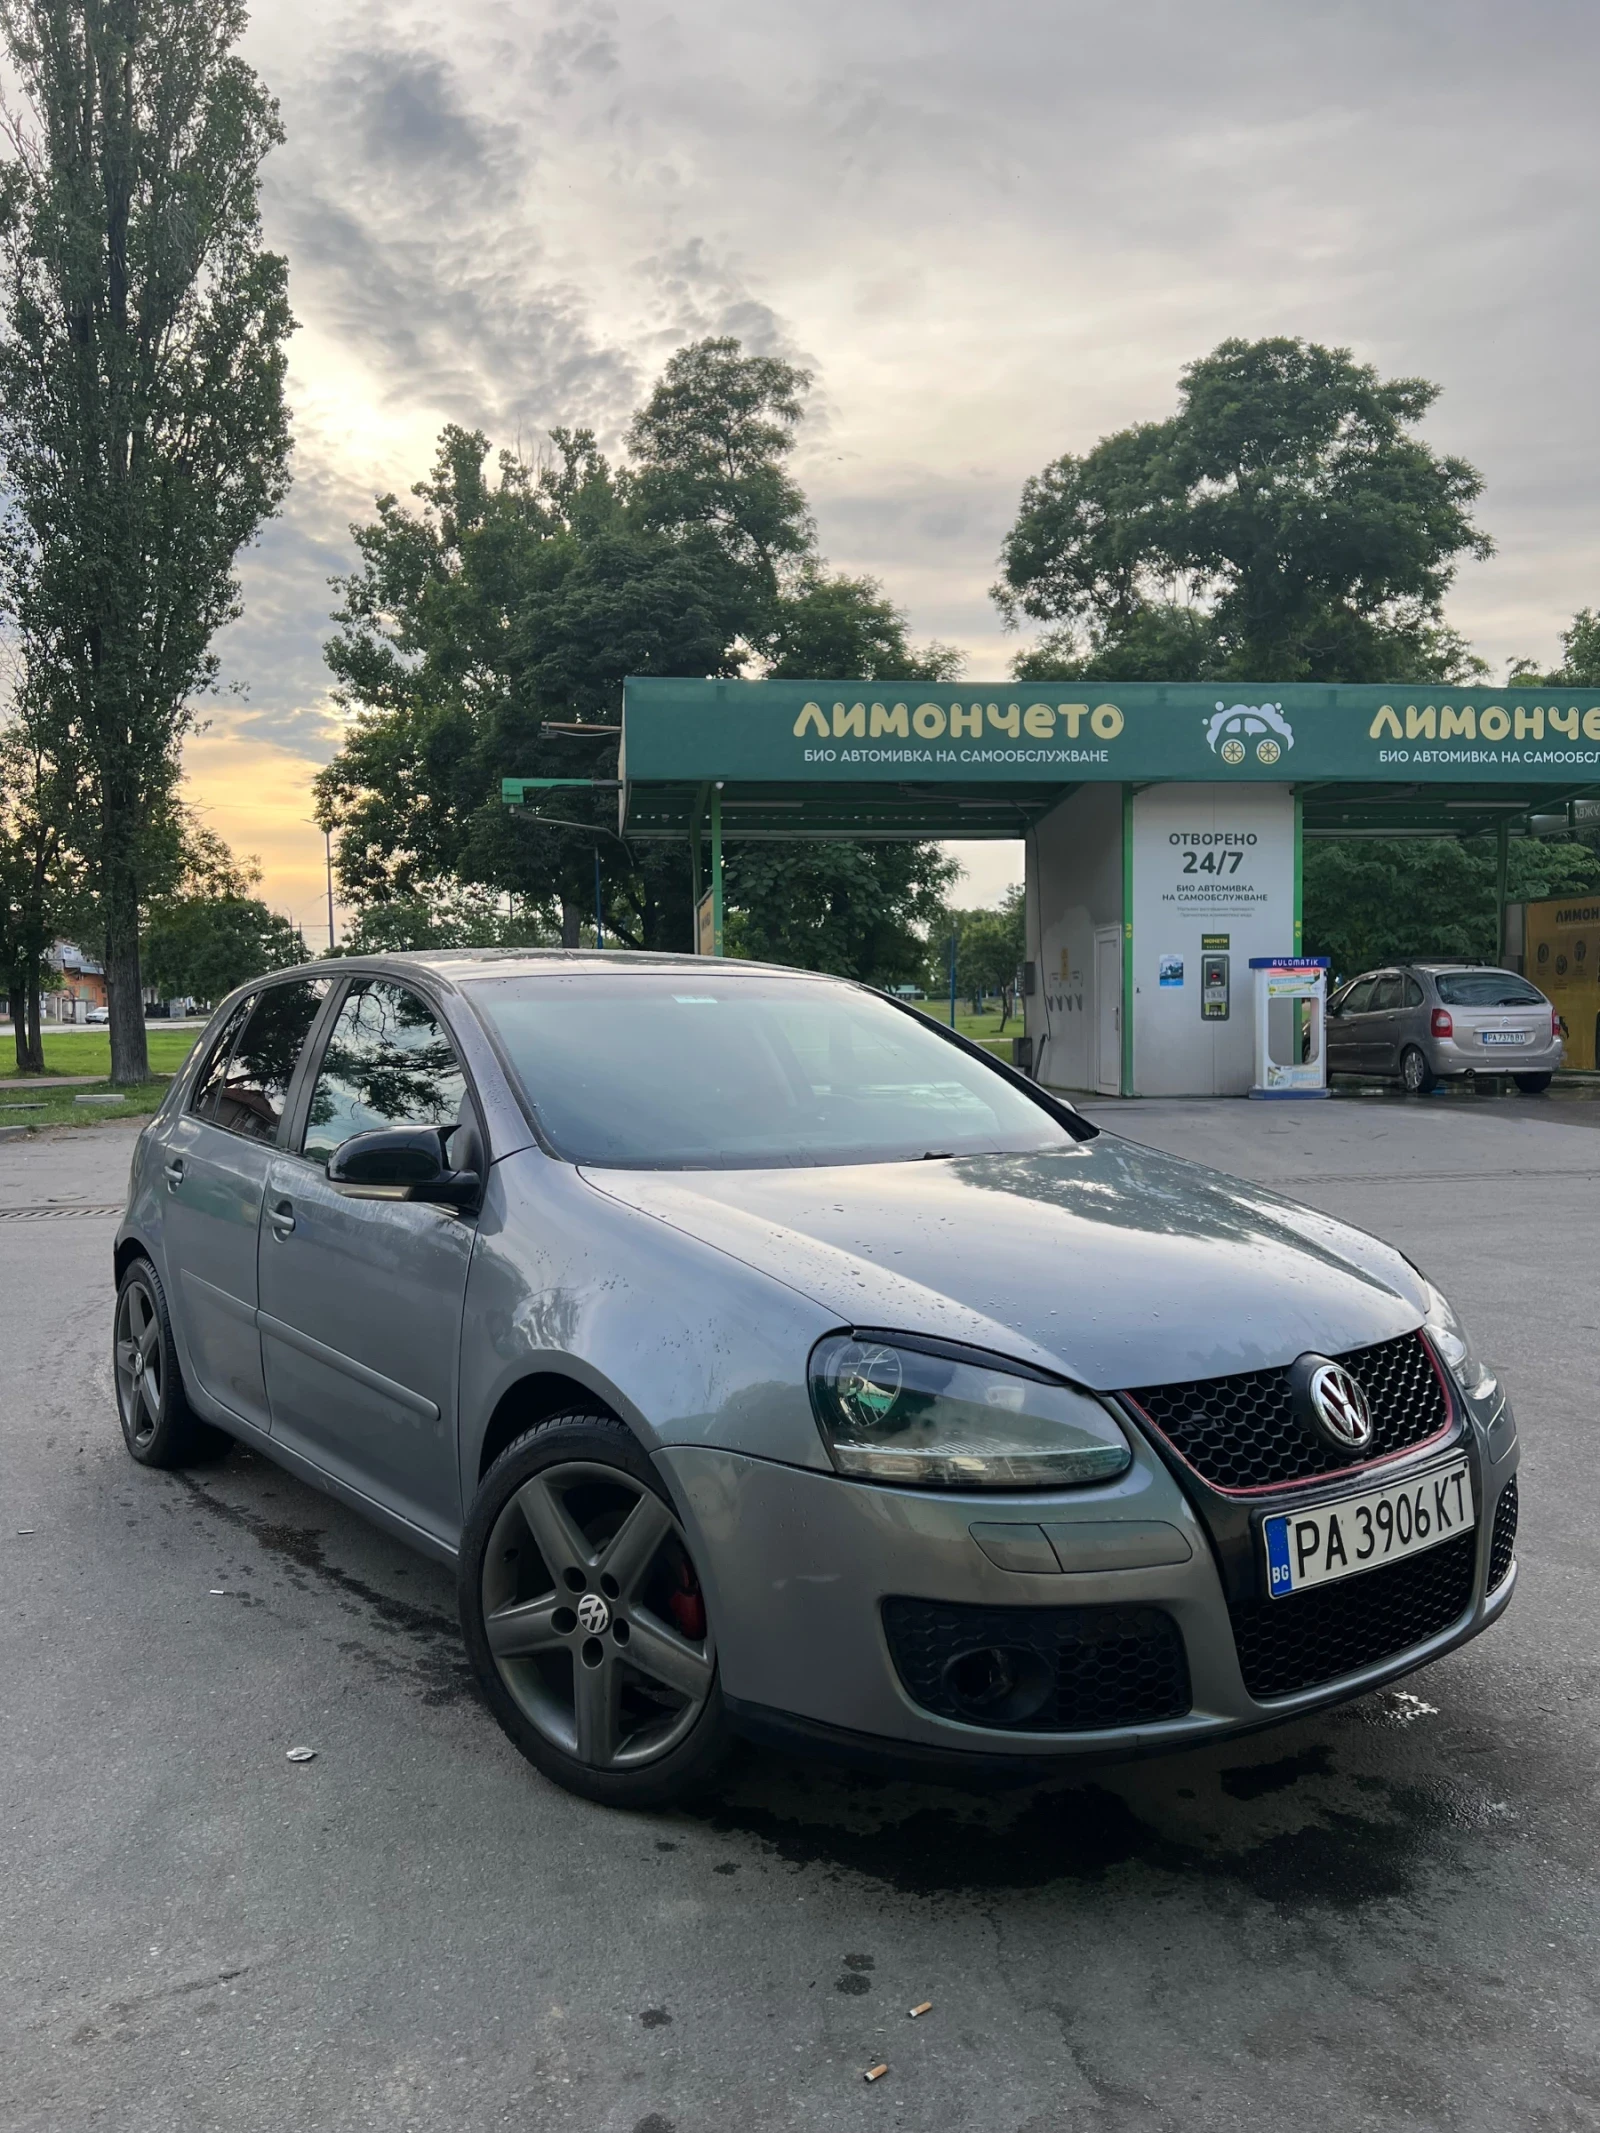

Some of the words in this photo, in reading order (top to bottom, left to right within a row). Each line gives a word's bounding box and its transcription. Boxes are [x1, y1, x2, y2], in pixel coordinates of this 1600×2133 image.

[804, 749, 837, 762] БИО
[840, 749, 933, 763] АВТОМИВКА
[936, 750, 957, 762] НА
[960, 750, 1109, 763] САМООБСЛУЖВАНЕ
[1379, 751, 1409, 763] БИО
[1413, 751, 1498, 763] АВТОМИВКА
[1501, 752, 1520, 763] НА
[1169, 833, 1258, 846] ОТВОРЕНО
[1182, 850, 1244, 876] 24/7
[1176, 884, 1195, 892] БИО
[1197, 884, 1254, 892] АВТОМИВКА
[1295, 1514, 1348, 1578] PA
[1355, 1486, 1431, 1559] 3906
[1434, 1469, 1466, 1532] KT
[1272, 1564, 1290, 1584] BG
